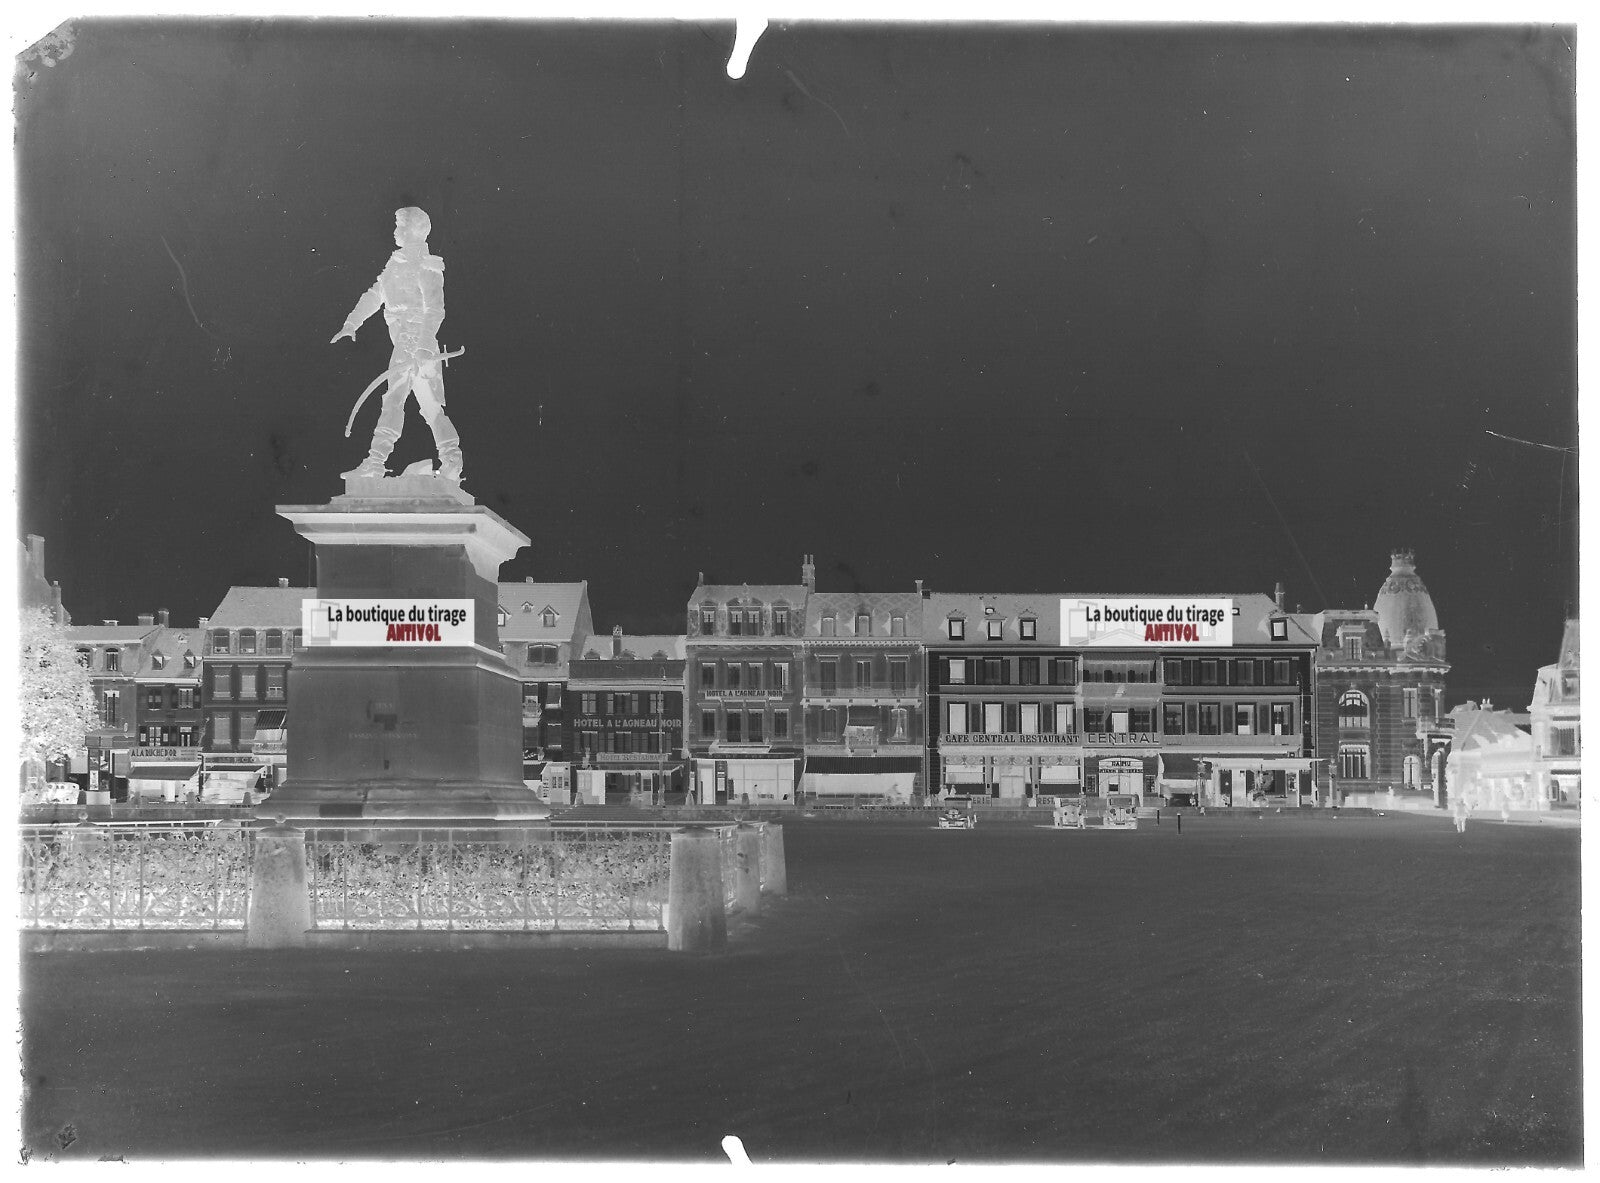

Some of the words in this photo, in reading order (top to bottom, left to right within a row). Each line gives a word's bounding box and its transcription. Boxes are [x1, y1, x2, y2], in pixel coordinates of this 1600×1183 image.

[573, 718, 604, 727] HOTEL
[607, 718, 614, 727] A
[615, 718, 657, 727] L'AGNEAU
[660, 718, 682, 727] NOIR
[945, 734, 970, 743] CAFE
[973, 734, 1016, 743] CENTRAL
[1019, 734, 1080, 743] RESTAURANT
[1088, 733, 1159, 744] CENTRAL
